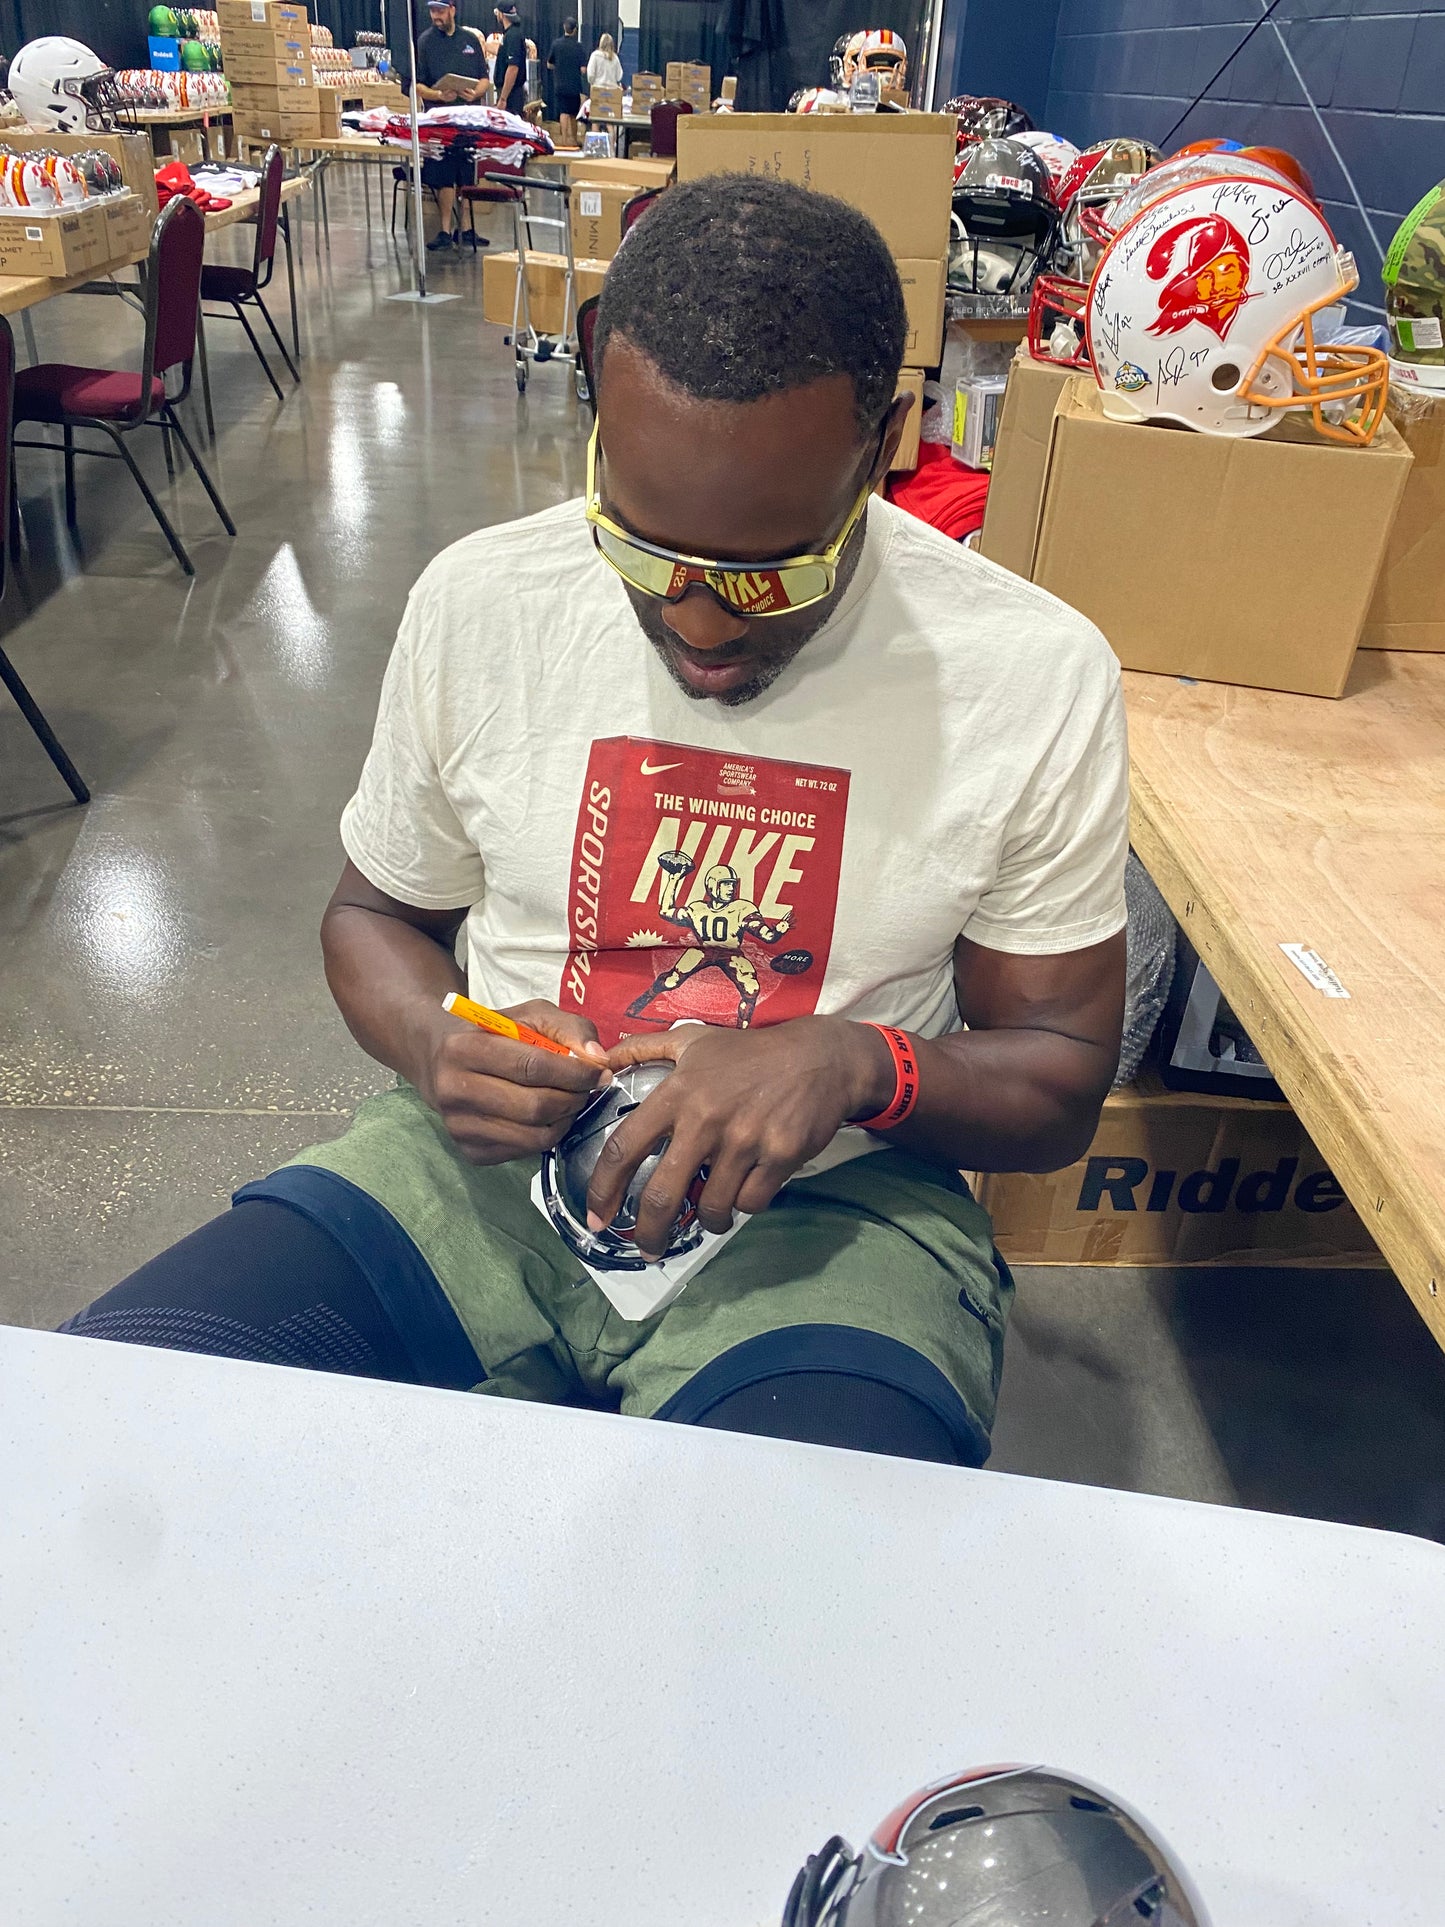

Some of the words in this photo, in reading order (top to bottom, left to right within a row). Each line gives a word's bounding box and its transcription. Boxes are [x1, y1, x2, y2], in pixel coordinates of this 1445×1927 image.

[589, 220, 599, 255] MINI
[718, 769, 757, 781] SPORTSWEAR
[722, 762, 755, 773] AMERICA'S
[723, 777, 752, 787] COMPANY
[795, 777, 808, 788] NET
[819, 781, 828, 790] 72
[828, 782, 838, 792] OZ
[654, 792, 685, 812] THE
[688, 797, 756, 822] WINNING
[760, 808, 817, 829] CHOICE
[629, 816, 816, 920] NIKE
[567, 780, 610, 1006] SPORTSWAR
[699, 915, 728, 942] 10
[782, 954, 809, 963] MORE
[902, 1059, 914, 1075] IS
